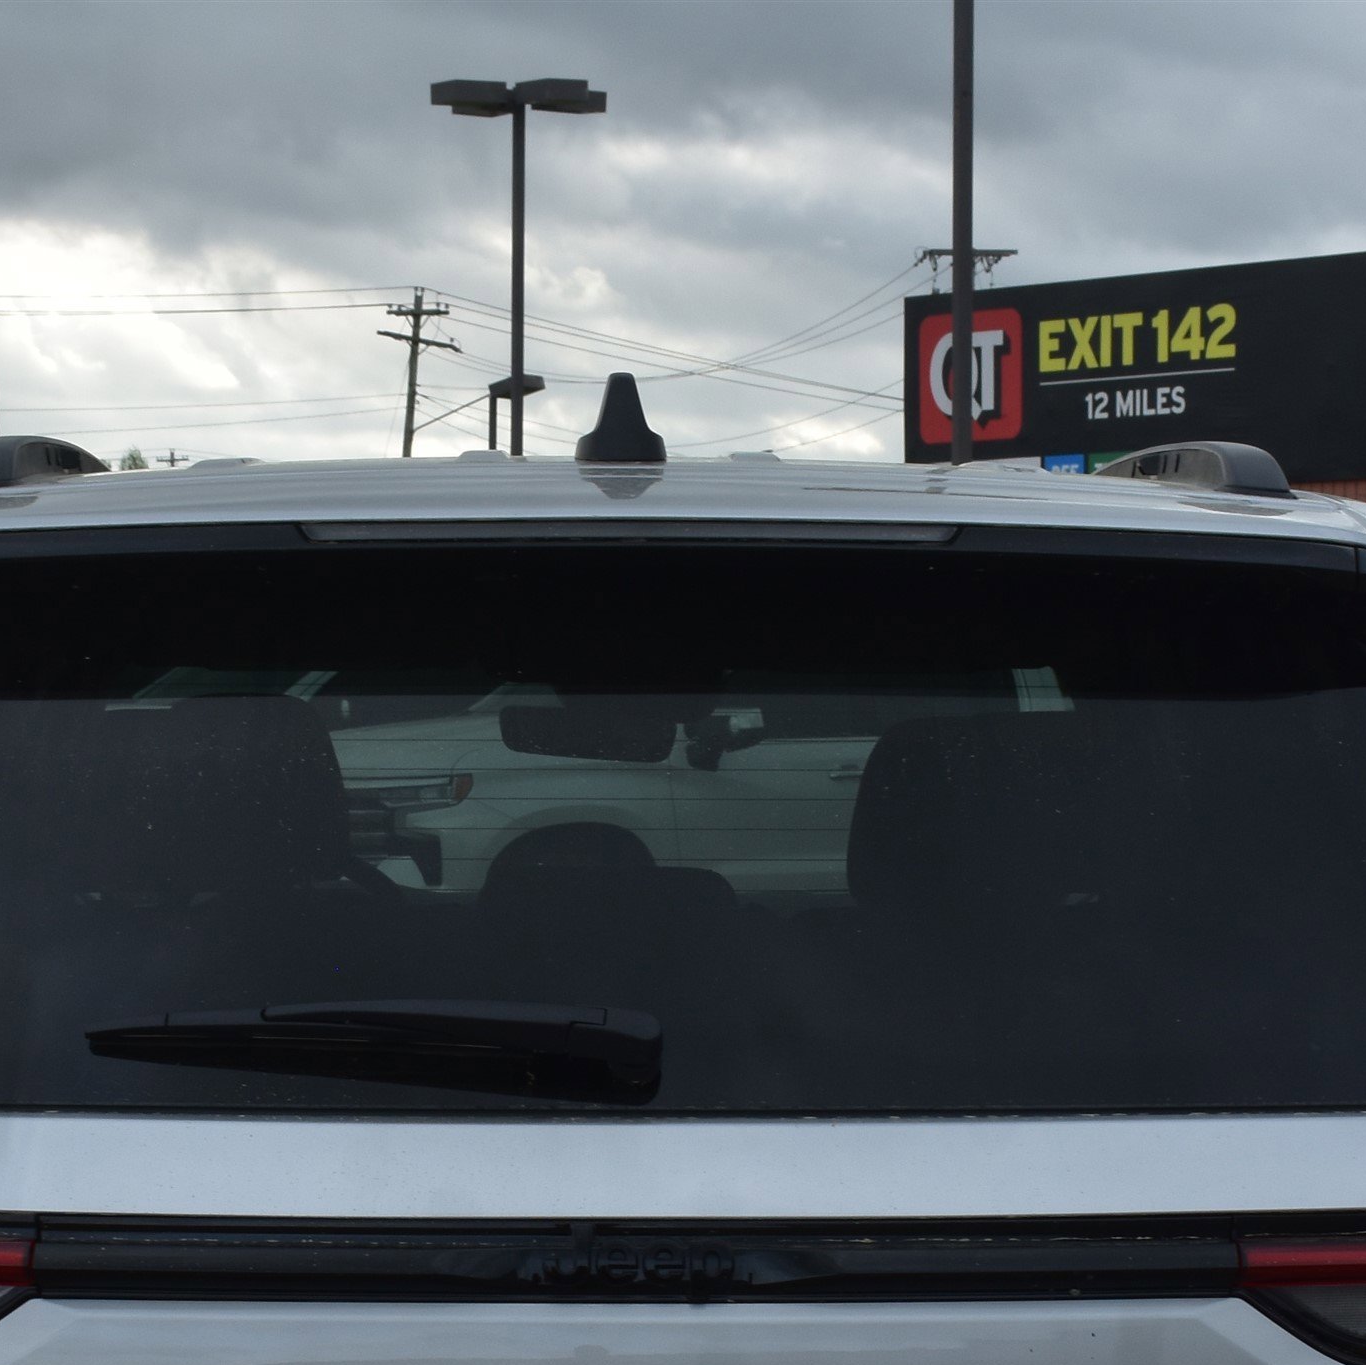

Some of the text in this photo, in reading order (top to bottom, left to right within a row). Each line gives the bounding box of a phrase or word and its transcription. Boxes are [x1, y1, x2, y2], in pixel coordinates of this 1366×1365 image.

[1039, 303, 1237, 373] EXIT 142
[929, 329, 1004, 422] QT
[1085, 386, 1186, 420] 12 MILES
